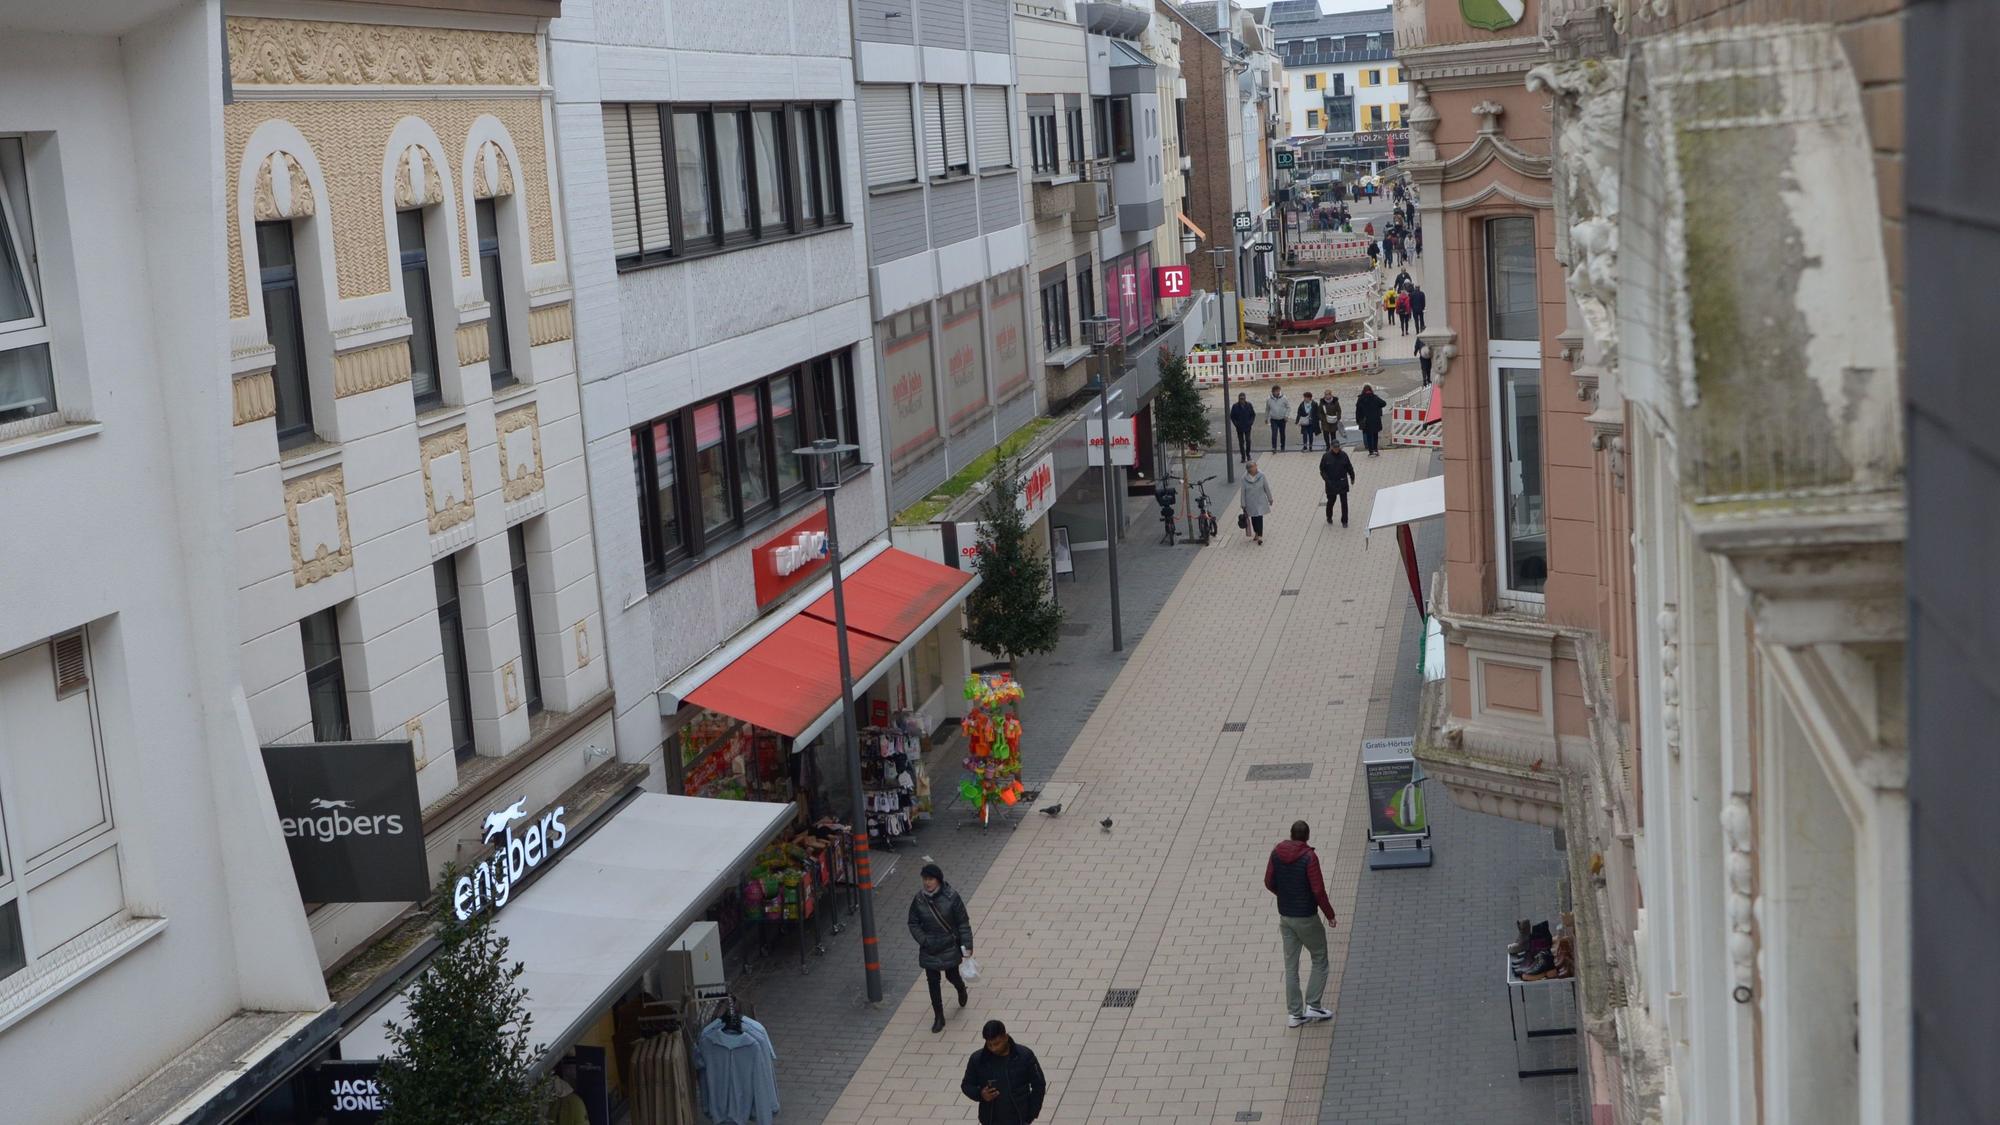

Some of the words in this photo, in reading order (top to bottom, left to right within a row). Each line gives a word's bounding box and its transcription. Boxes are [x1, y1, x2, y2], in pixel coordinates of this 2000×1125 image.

[1165, 271, 1183, 293] T
[281, 810, 403, 842] engbers
[455, 806, 566, 921] engbers
[330, 1079, 380, 1095] JACK
